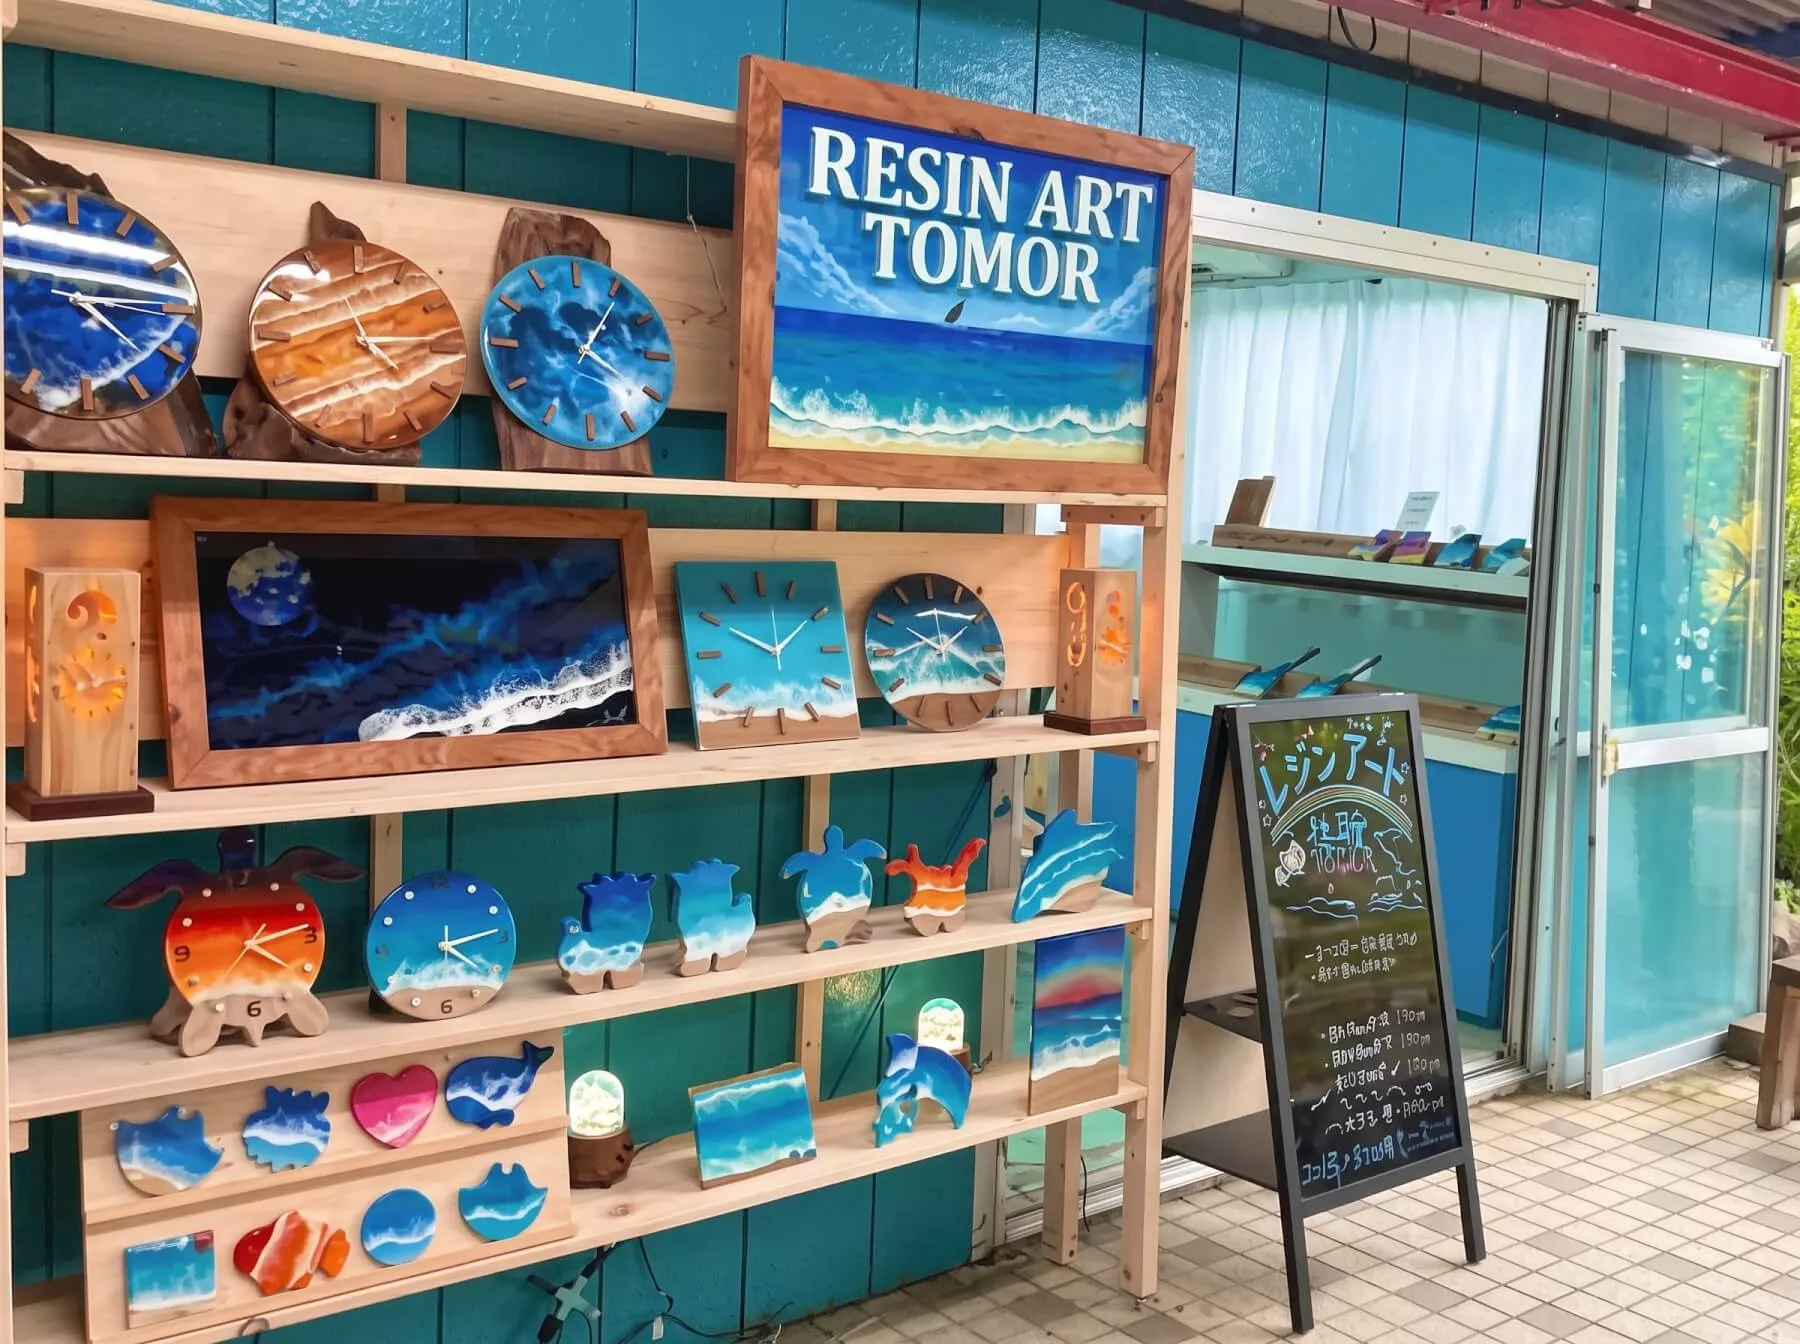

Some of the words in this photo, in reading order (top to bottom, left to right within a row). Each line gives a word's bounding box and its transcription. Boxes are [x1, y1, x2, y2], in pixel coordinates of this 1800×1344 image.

[808, 126, 1013, 223] RESIN
[1028, 169, 1154, 244] ART
[863, 212, 1101, 305] TOMOR
[1259, 733, 1405, 816] レジンアート
[304, 927, 317, 944] 3
[174, 945, 191, 962] 9
[247, 1001, 262, 1017] 6
[440, 999, 453, 1014] 6
